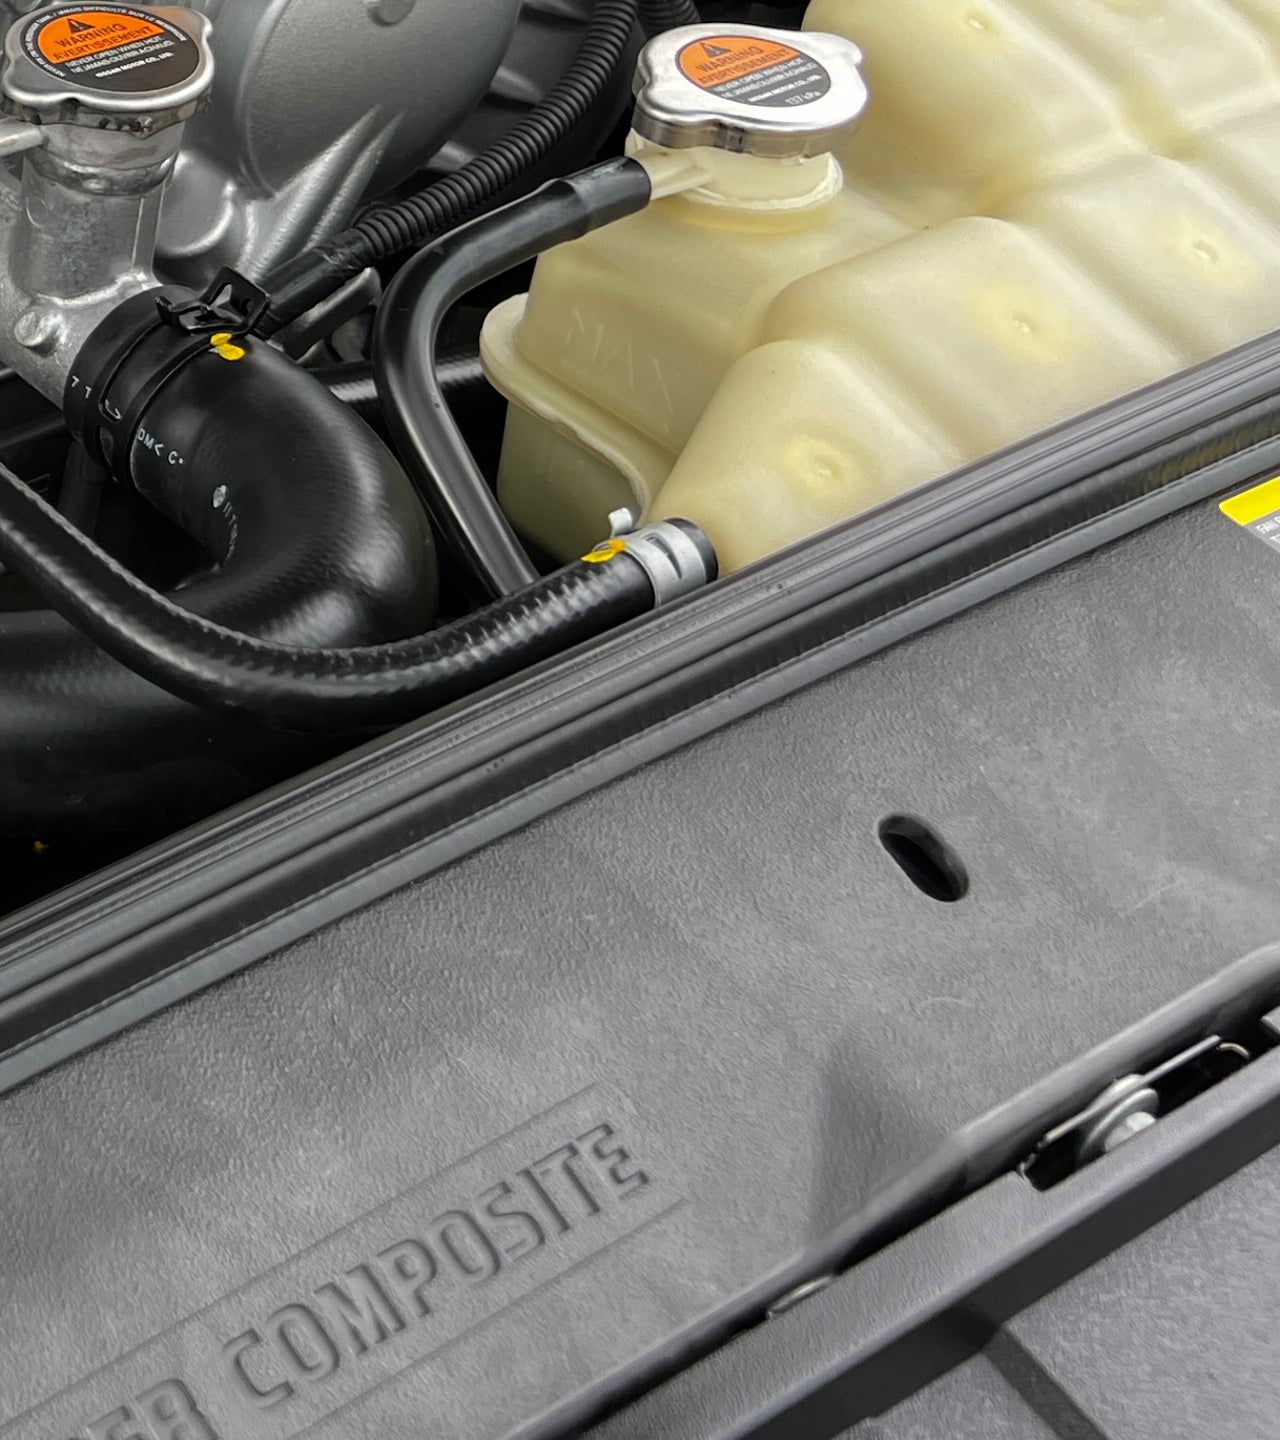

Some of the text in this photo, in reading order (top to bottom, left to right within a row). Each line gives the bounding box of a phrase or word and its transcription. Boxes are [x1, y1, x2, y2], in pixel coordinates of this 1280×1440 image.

[53, 26, 154, 61] AVERTISSEMENT
[55, 23, 127, 48] WARNING
[695, 45, 765, 72] WARNING
[222, 1121, 651, 1410] COMPOSITE
